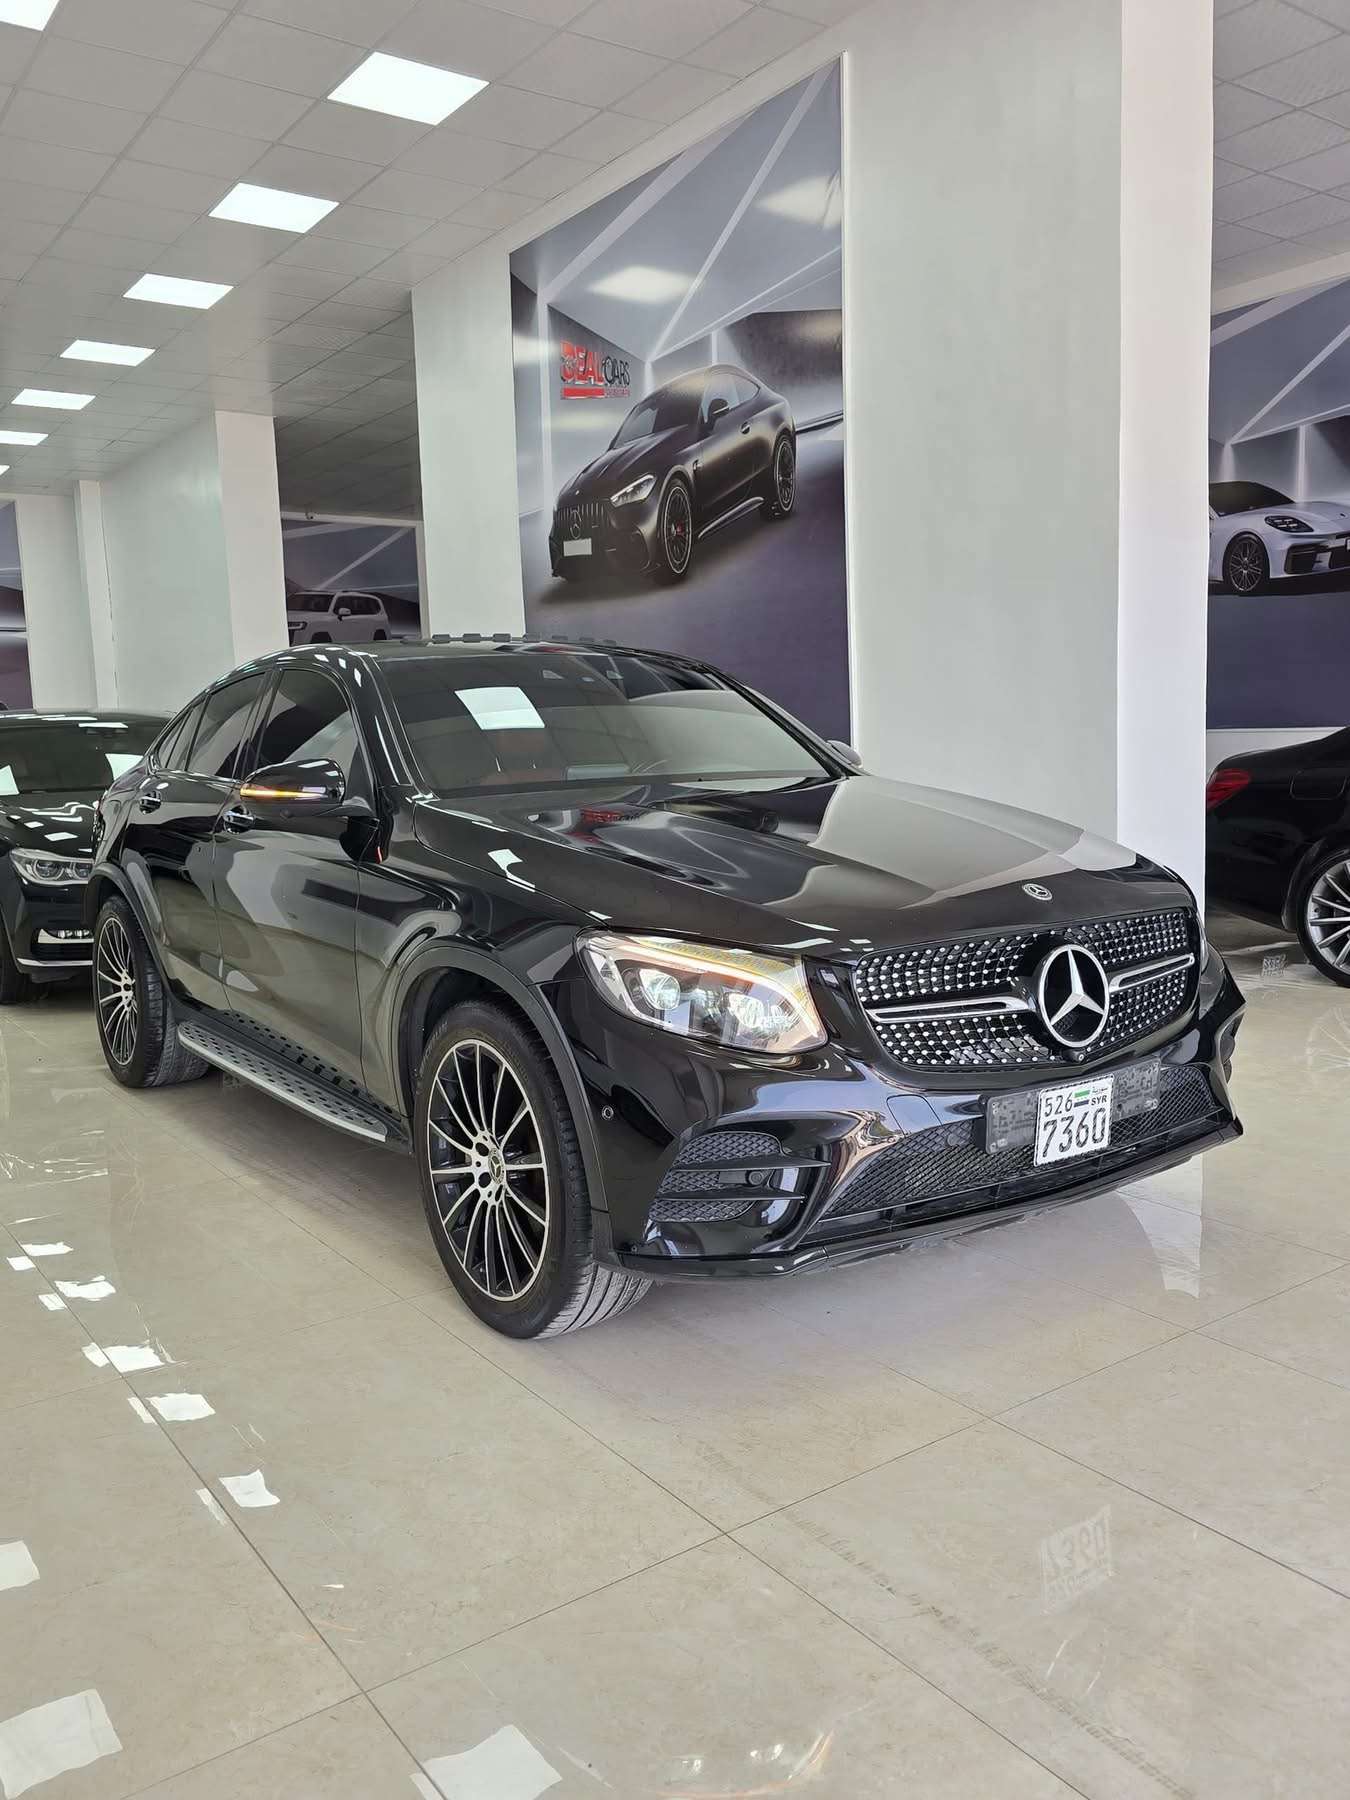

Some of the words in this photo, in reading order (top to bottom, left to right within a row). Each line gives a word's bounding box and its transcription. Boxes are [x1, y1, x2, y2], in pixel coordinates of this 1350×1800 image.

[1044, 1092, 1073, 1117] 526
[1091, 1095, 1107, 1106] SYR
[1042, 1108, 1107, 1158] 7360
